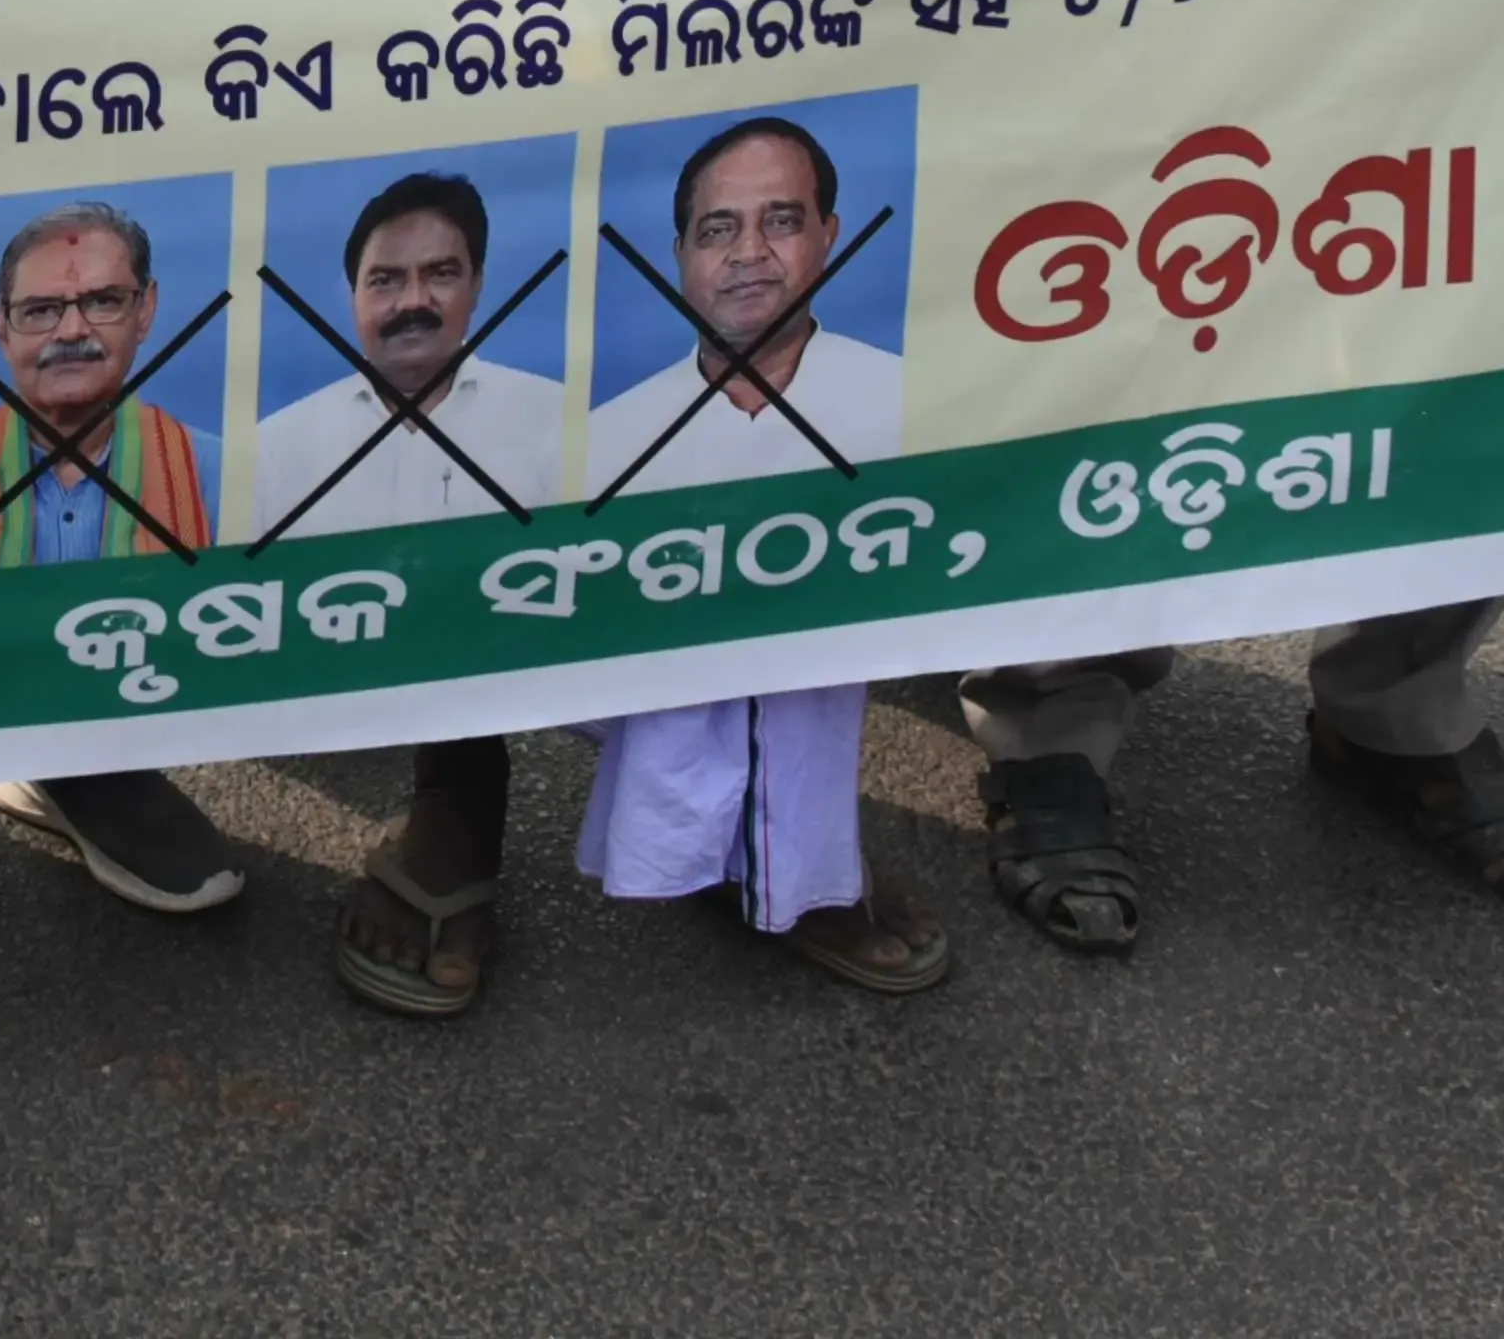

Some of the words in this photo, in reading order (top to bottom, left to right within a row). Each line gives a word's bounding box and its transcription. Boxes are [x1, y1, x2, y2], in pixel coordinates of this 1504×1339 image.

[203, 24, 334, 123] କିଏ
[973, 124, 1476, 354] ଓଡ଼ିଶା
[52, 566, 409, 705] କୃଷକ
[1058, 421, 1392, 552] ଓଡ଼ିଶା
